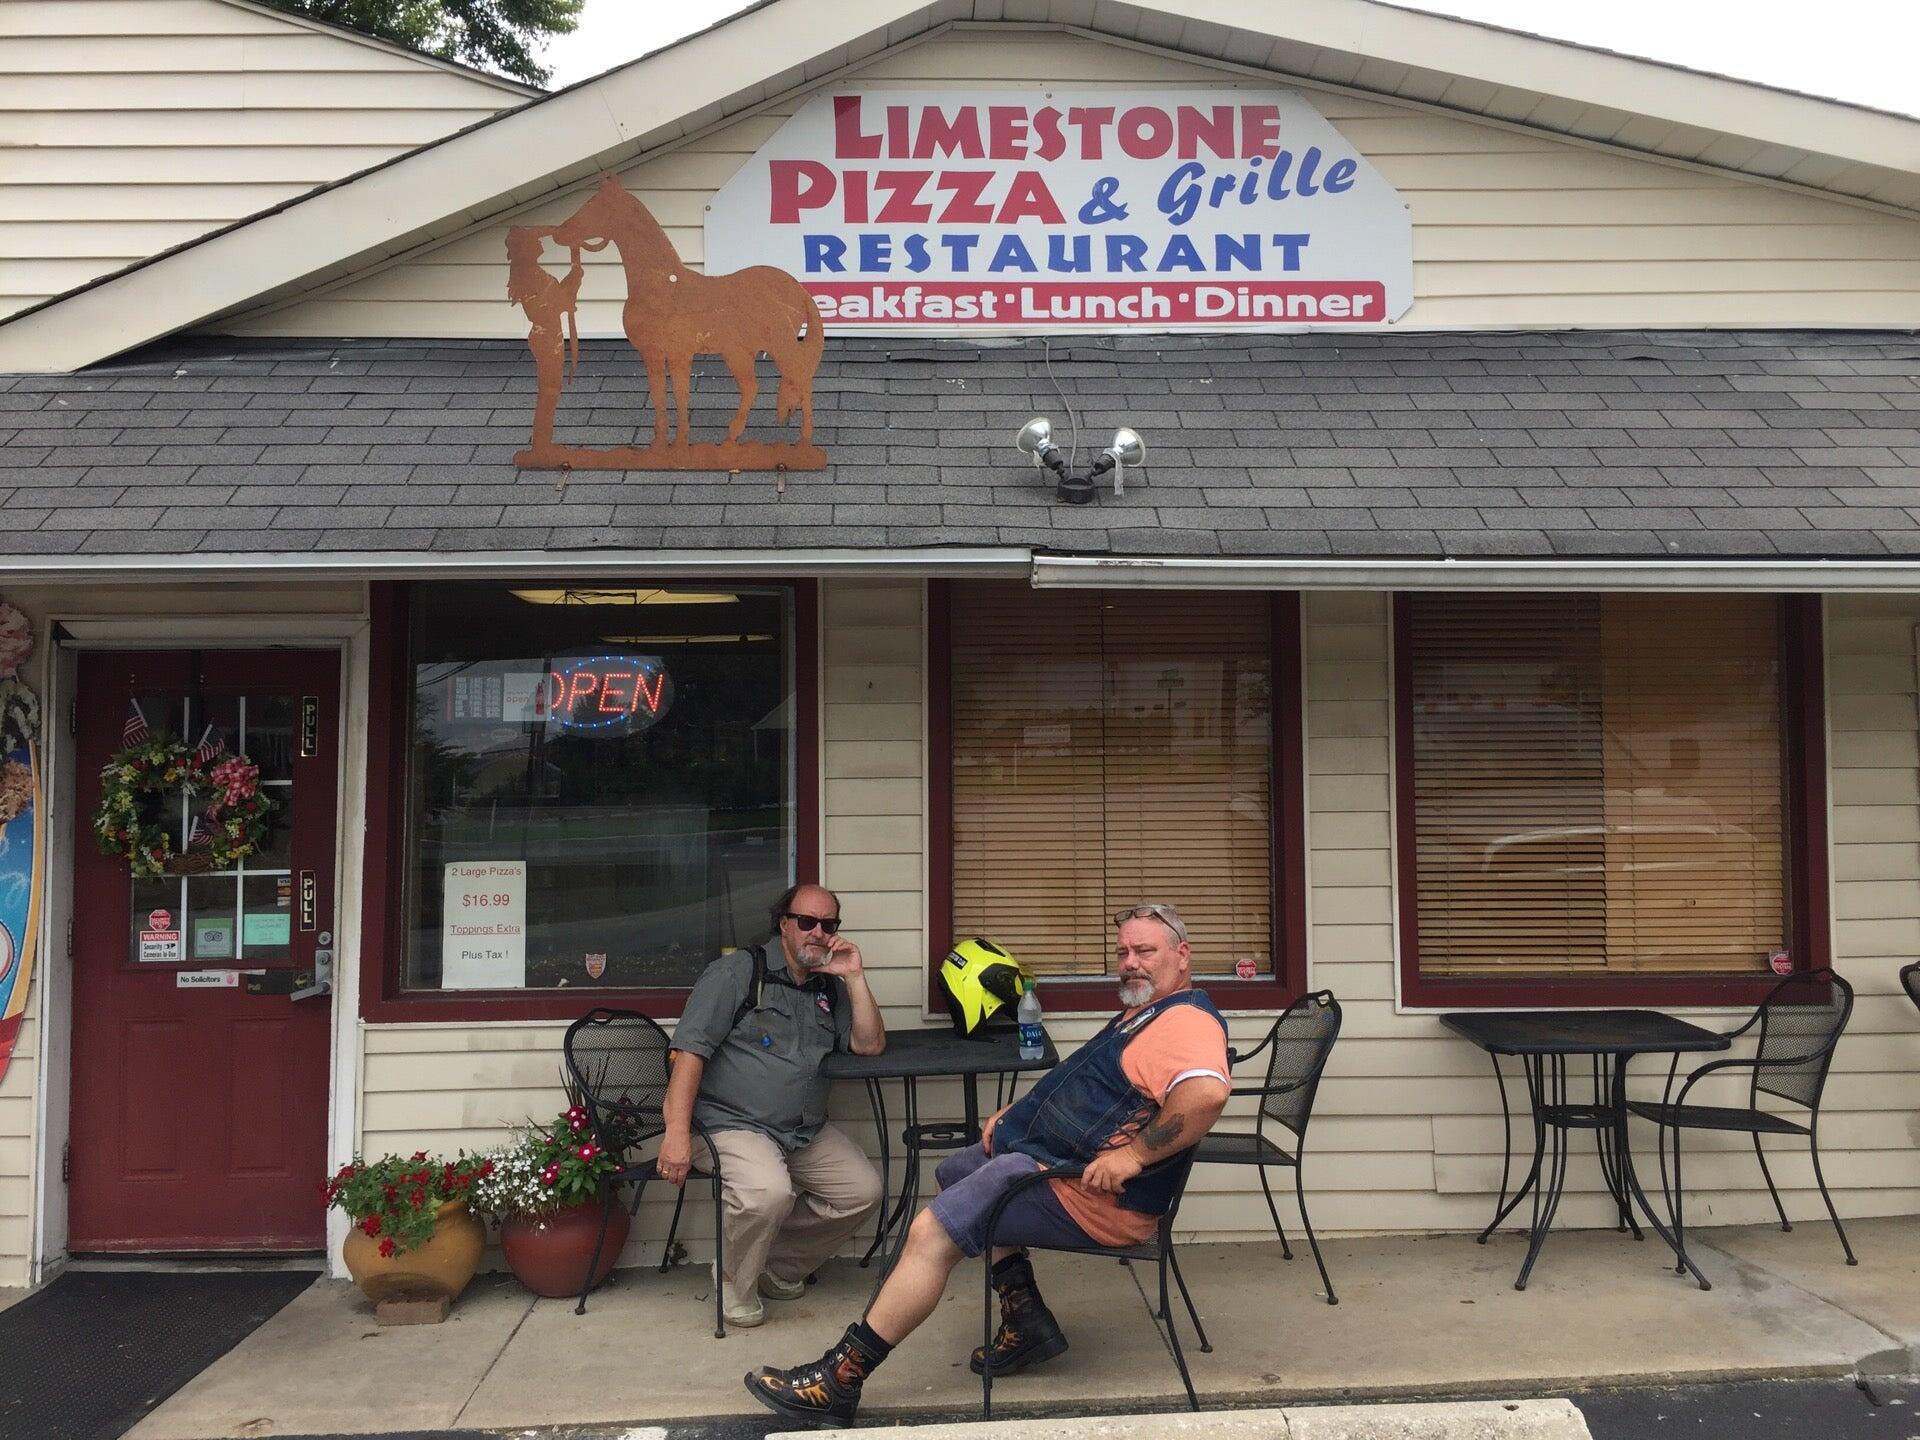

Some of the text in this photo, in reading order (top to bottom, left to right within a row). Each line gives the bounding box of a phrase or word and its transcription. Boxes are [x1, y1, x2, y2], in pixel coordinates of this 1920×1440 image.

[833, 95, 1280, 161] LIMESTONE
[769, 146, 1357, 226] PIZZA & Grille
[803, 233, 1310, 273] RESTAURANT
[812, 286, 1373, 319] eakfast Lunch Dinner
[305, 704, 316, 749] PULL
[451, 867, 522, 878] 2 Large Pizza's
[303, 878, 314, 923] PULL
[462, 894, 511, 907] $16.99
[142, 933, 178, 941] WARNING
[450, 924, 521, 935] Toppings Extra
[143, 943, 163, 951] Security
[461, 950, 483, 959] Plus
[485, 950, 503, 959] Tax
